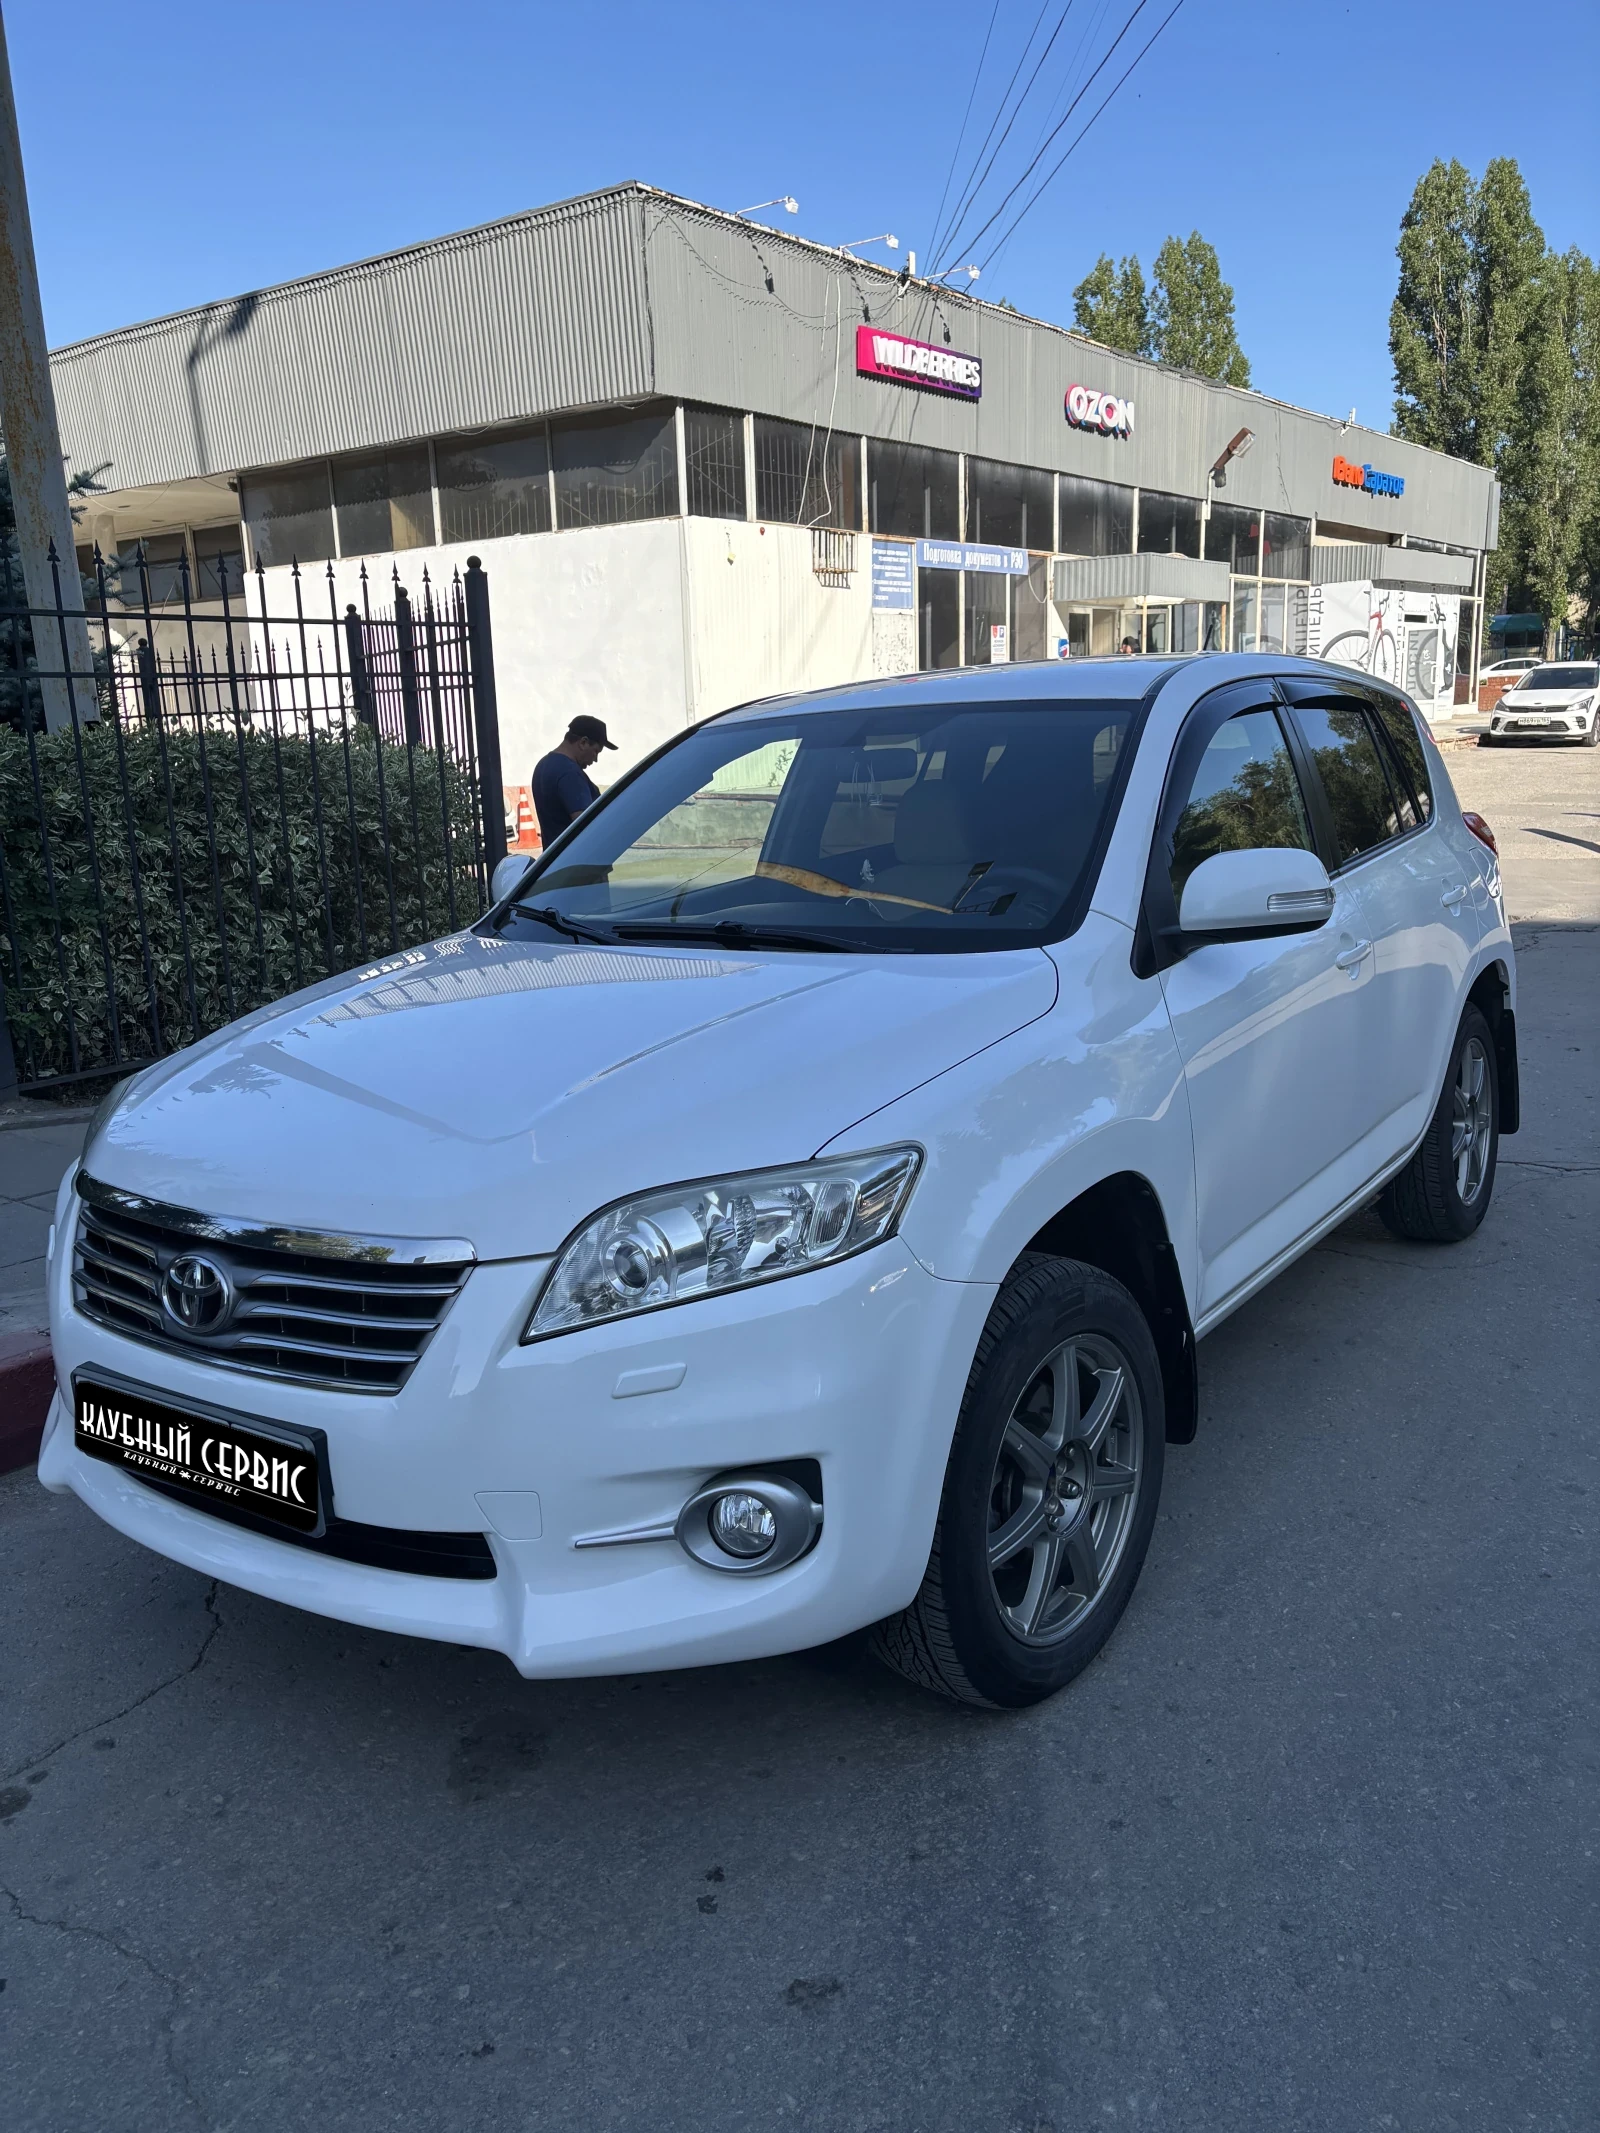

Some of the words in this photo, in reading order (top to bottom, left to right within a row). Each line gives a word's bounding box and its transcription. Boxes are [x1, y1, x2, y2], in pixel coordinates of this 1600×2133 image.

[871, 335, 981, 388] WILDBERRIES
[1066, 384, 1136, 434] OZON
[923, 543, 962, 564] Подготовка
[964, 551, 1001, 570] документов
[1003, 555, 1008, 568] в
[1010, 551, 1024, 569] РЭО
